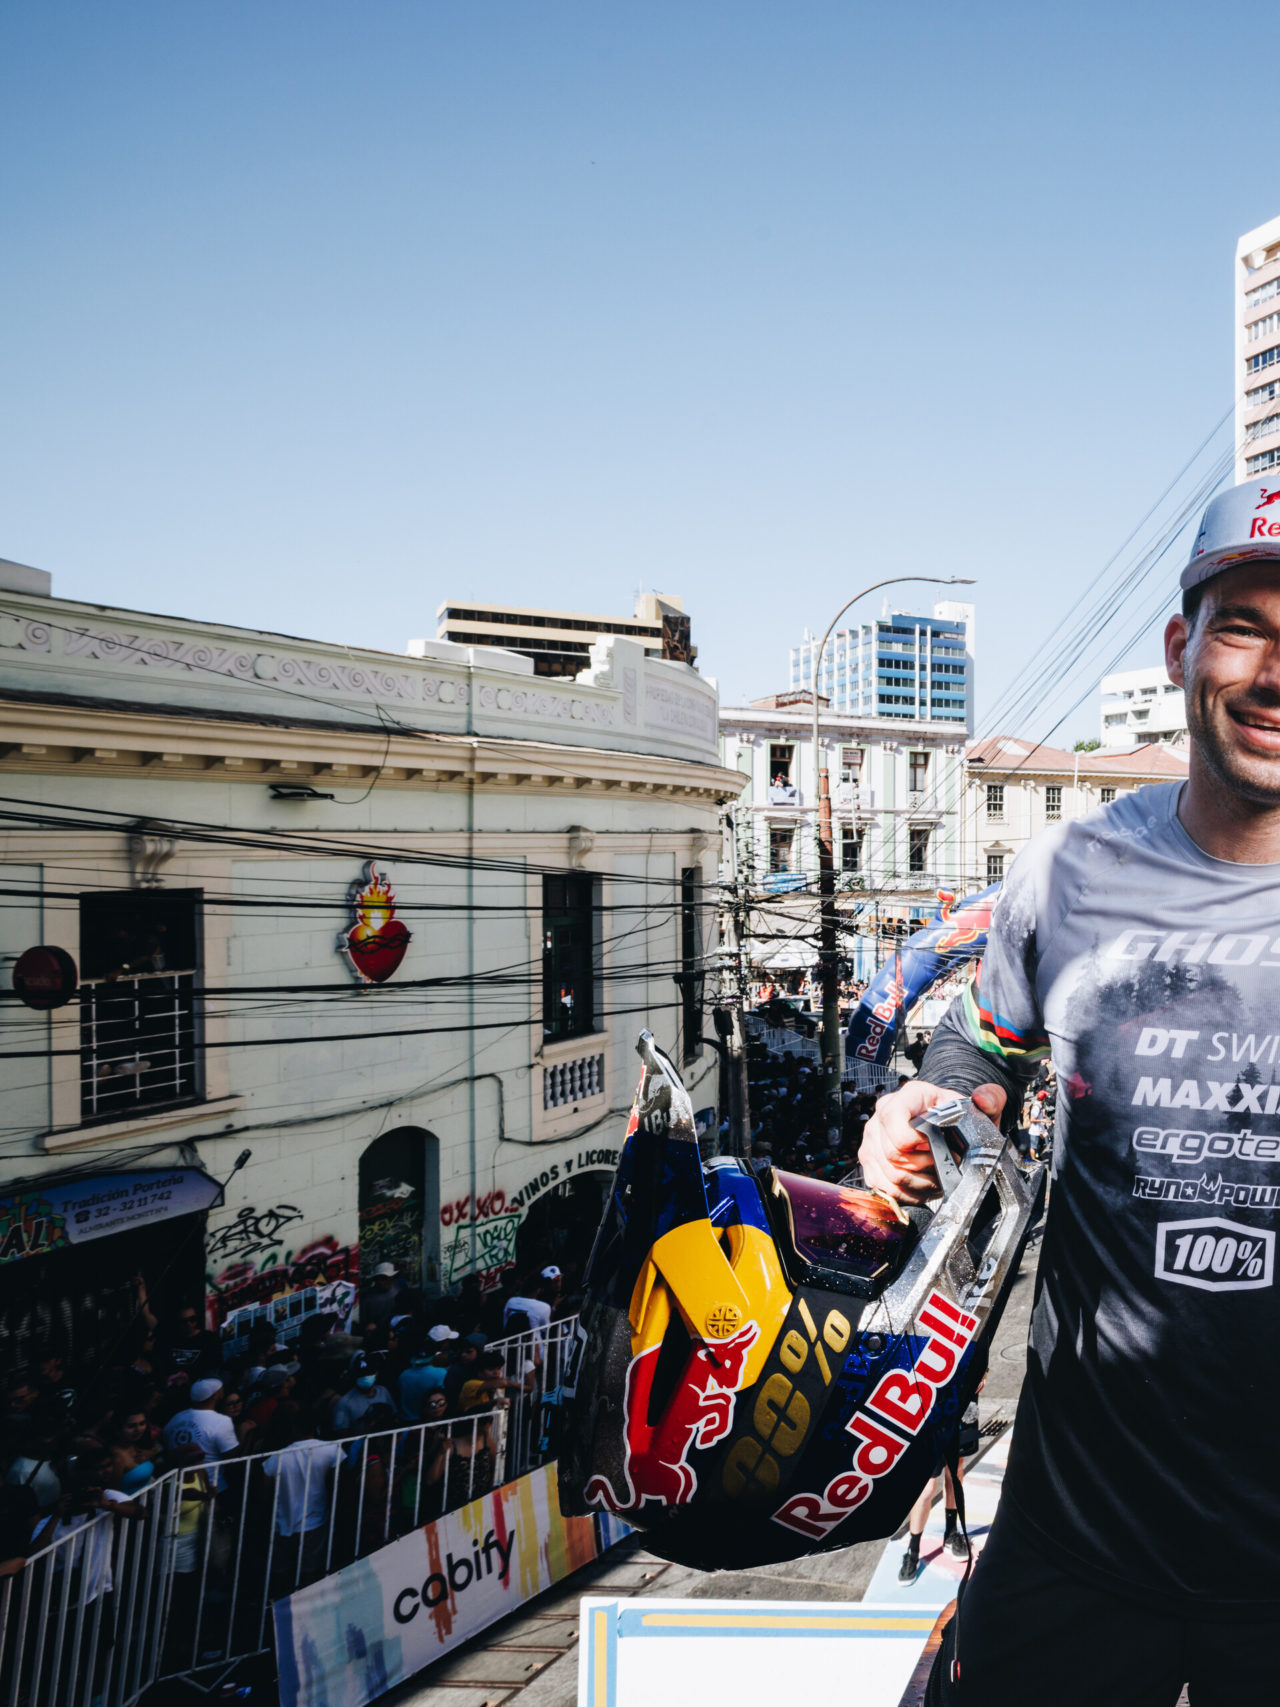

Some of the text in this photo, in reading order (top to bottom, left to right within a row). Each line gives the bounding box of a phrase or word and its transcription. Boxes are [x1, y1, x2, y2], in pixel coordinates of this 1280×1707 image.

[855, 980, 909, 1061] Red Bull
[1134, 1027, 1200, 1059] DT
[61, 1174, 184, 1213] Tradición Porteña
[94, 1206, 111, 1219] 32
[119, 1200, 136, 1213] 32
[150, 1190, 173, 1205] 742
[512, 1165, 560, 1208] VINOS
[564, 1159, 574, 1174] Y
[1173, 1233, 1264, 1278] 100%
[770, 1287, 981, 1541] Red Bull
[393, 1529, 515, 1624] cabify
